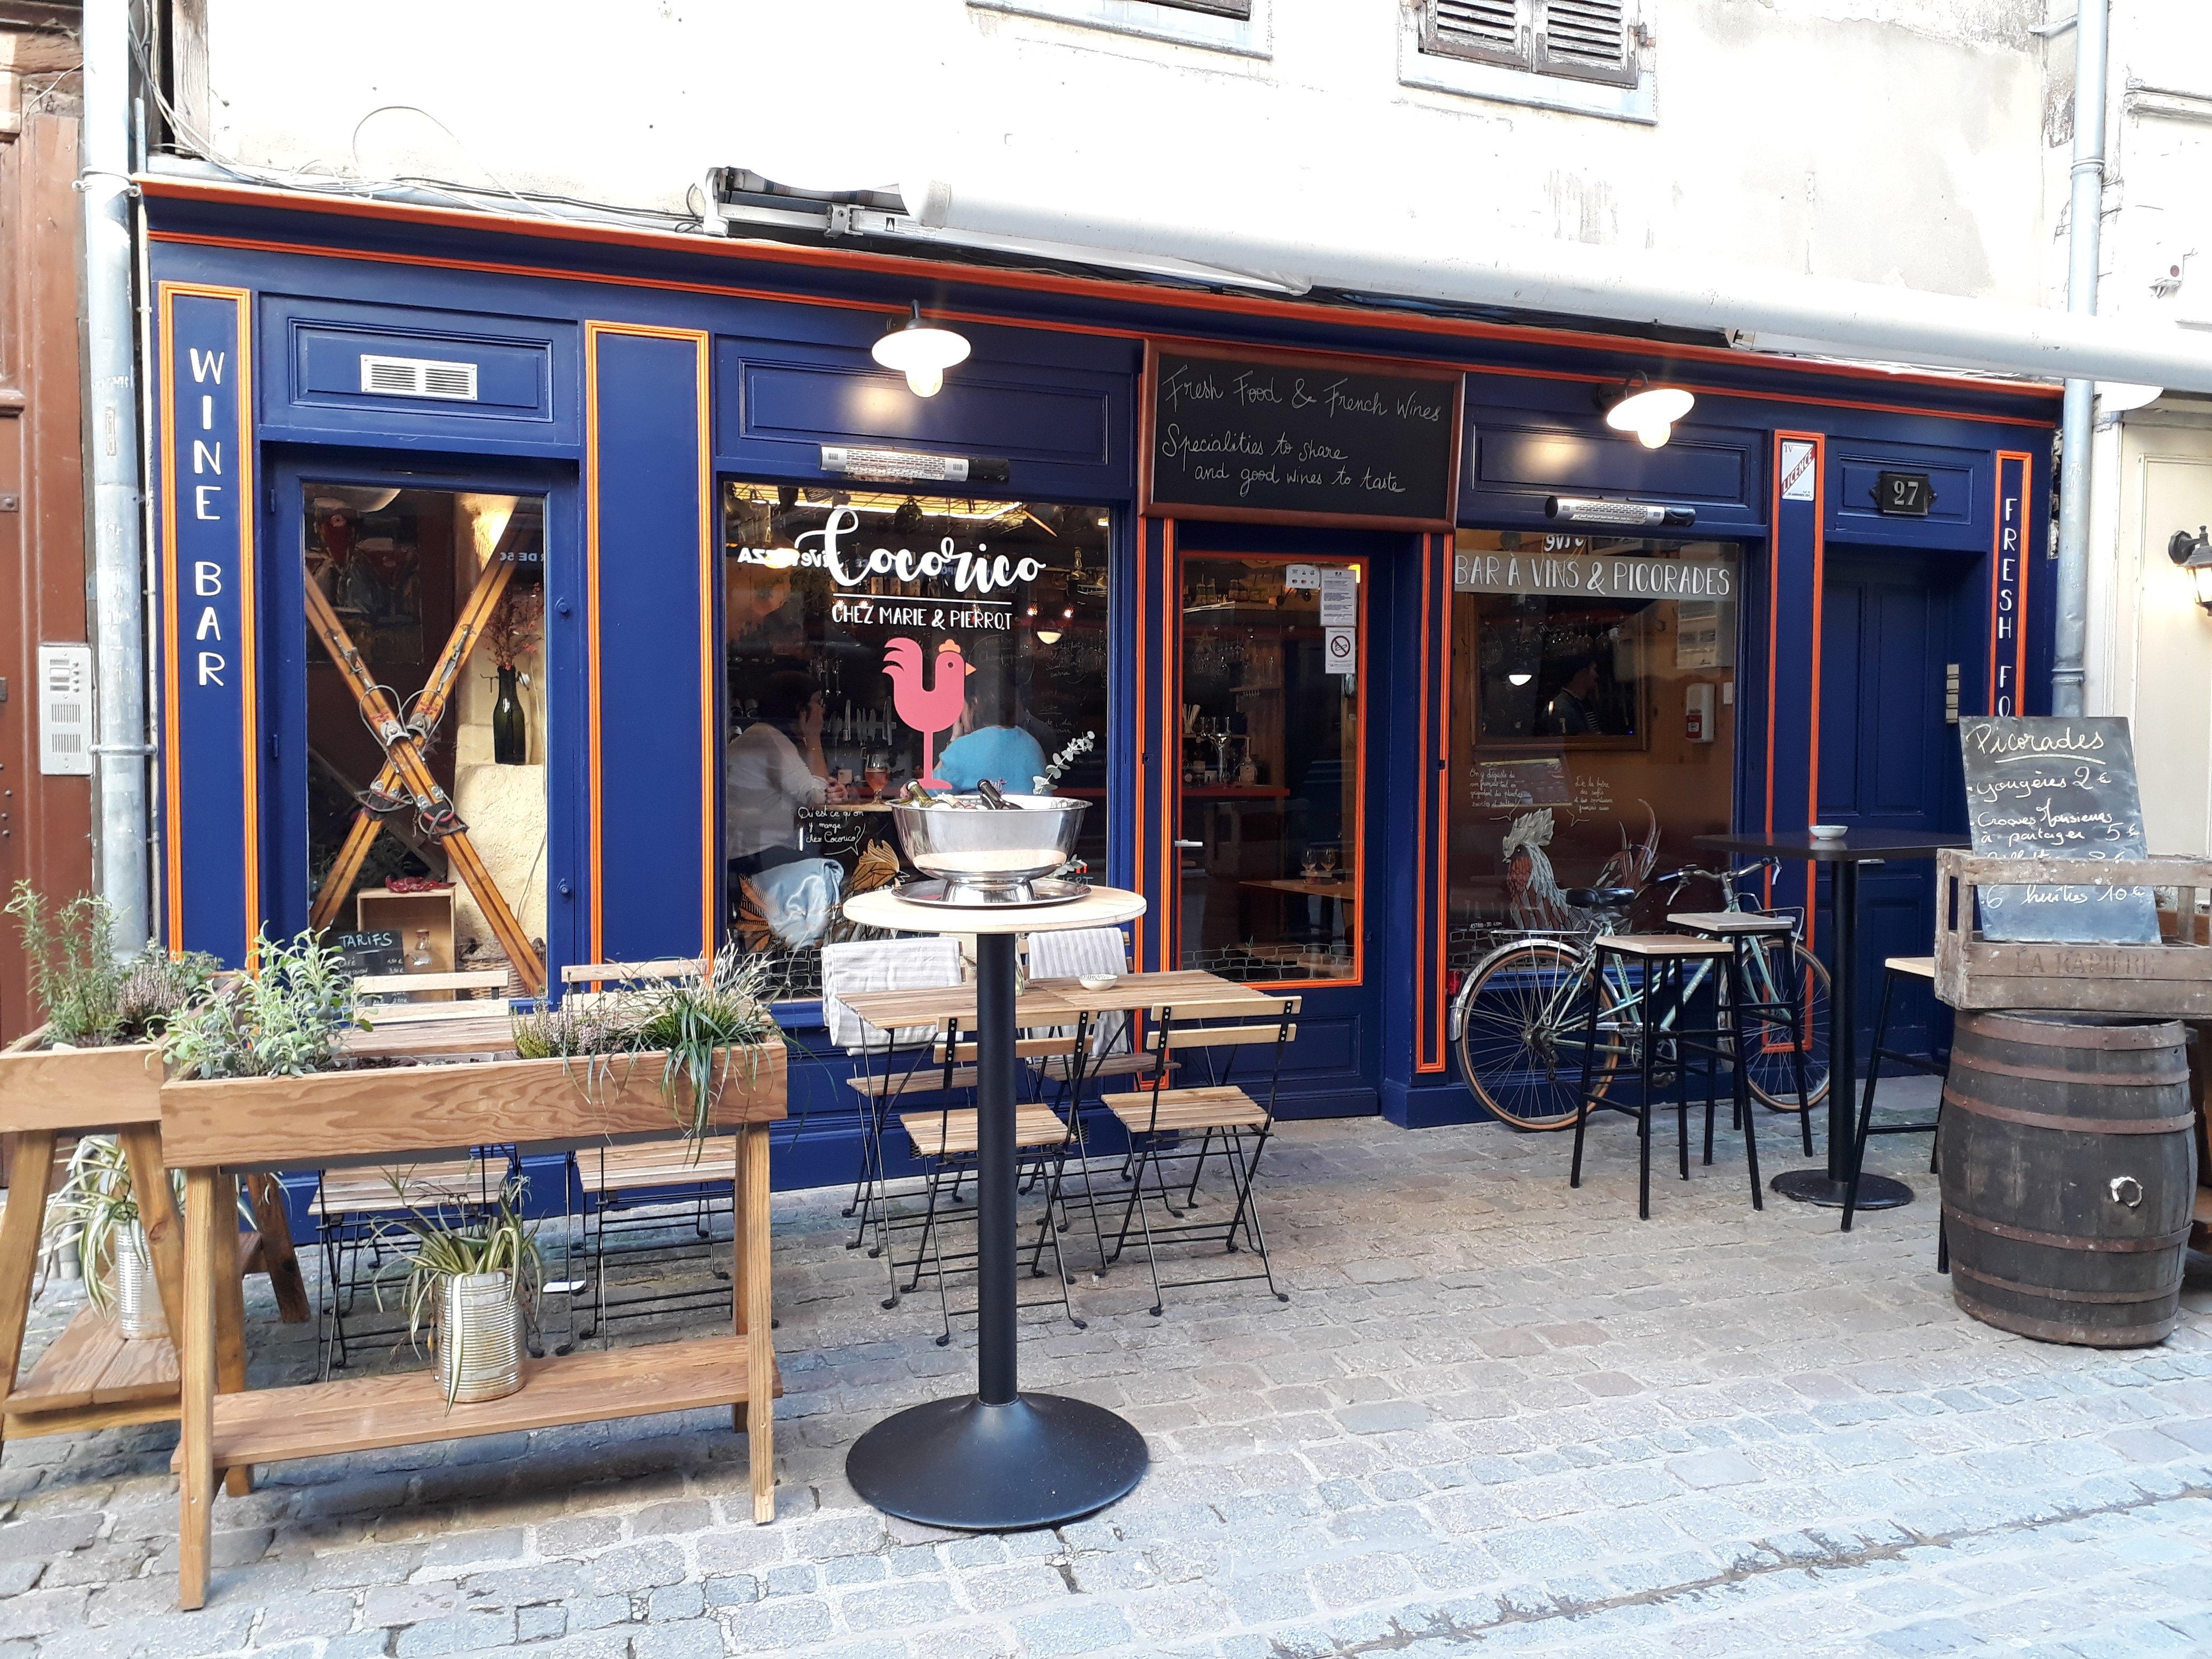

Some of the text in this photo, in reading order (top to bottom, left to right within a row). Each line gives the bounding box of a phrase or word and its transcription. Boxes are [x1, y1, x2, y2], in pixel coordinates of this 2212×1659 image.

[1162, 364, 1224, 412] Fresh
[1234, 370, 1282, 406] Food
[1292, 378, 1317, 408] &
[1323, 378, 1388, 418] French
[1162, 423, 1264, 472] Specialities
[1271, 431, 1292, 455] to
[1194, 462, 1230, 481] and
[1240, 464, 1280, 497] good
[1331, 464, 1351, 486] to
[1359, 466, 1407, 492] taste
[1783, 449, 1813, 493] LICENCE
[1893, 480, 1919, 506] 27
[189, 347, 225, 687] WINE BAR
[795, 507, 1046, 593] Cocorico
[1455, 552, 1730, 596] BAR À VINS & PICORADES
[832, 604, 875, 624] CHEZ
[879, 607, 927, 626] MARIE
[931, 608, 946, 630] &
[1998, 498, 2018, 717] FRESH FO
[1966, 723, 2104, 754] Picorades
[2072, 766, 2094, 790] 2
[809, 821, 841, 834] y mange
[1977, 811, 2036, 827] Croques
[806, 834, 822, 843] chez
[1981, 831, 1993, 843] à
[2008, 828, 2086, 847] partager
[2104, 823, 2125, 841] 5
[2096, 885, 2127, 902] 10
